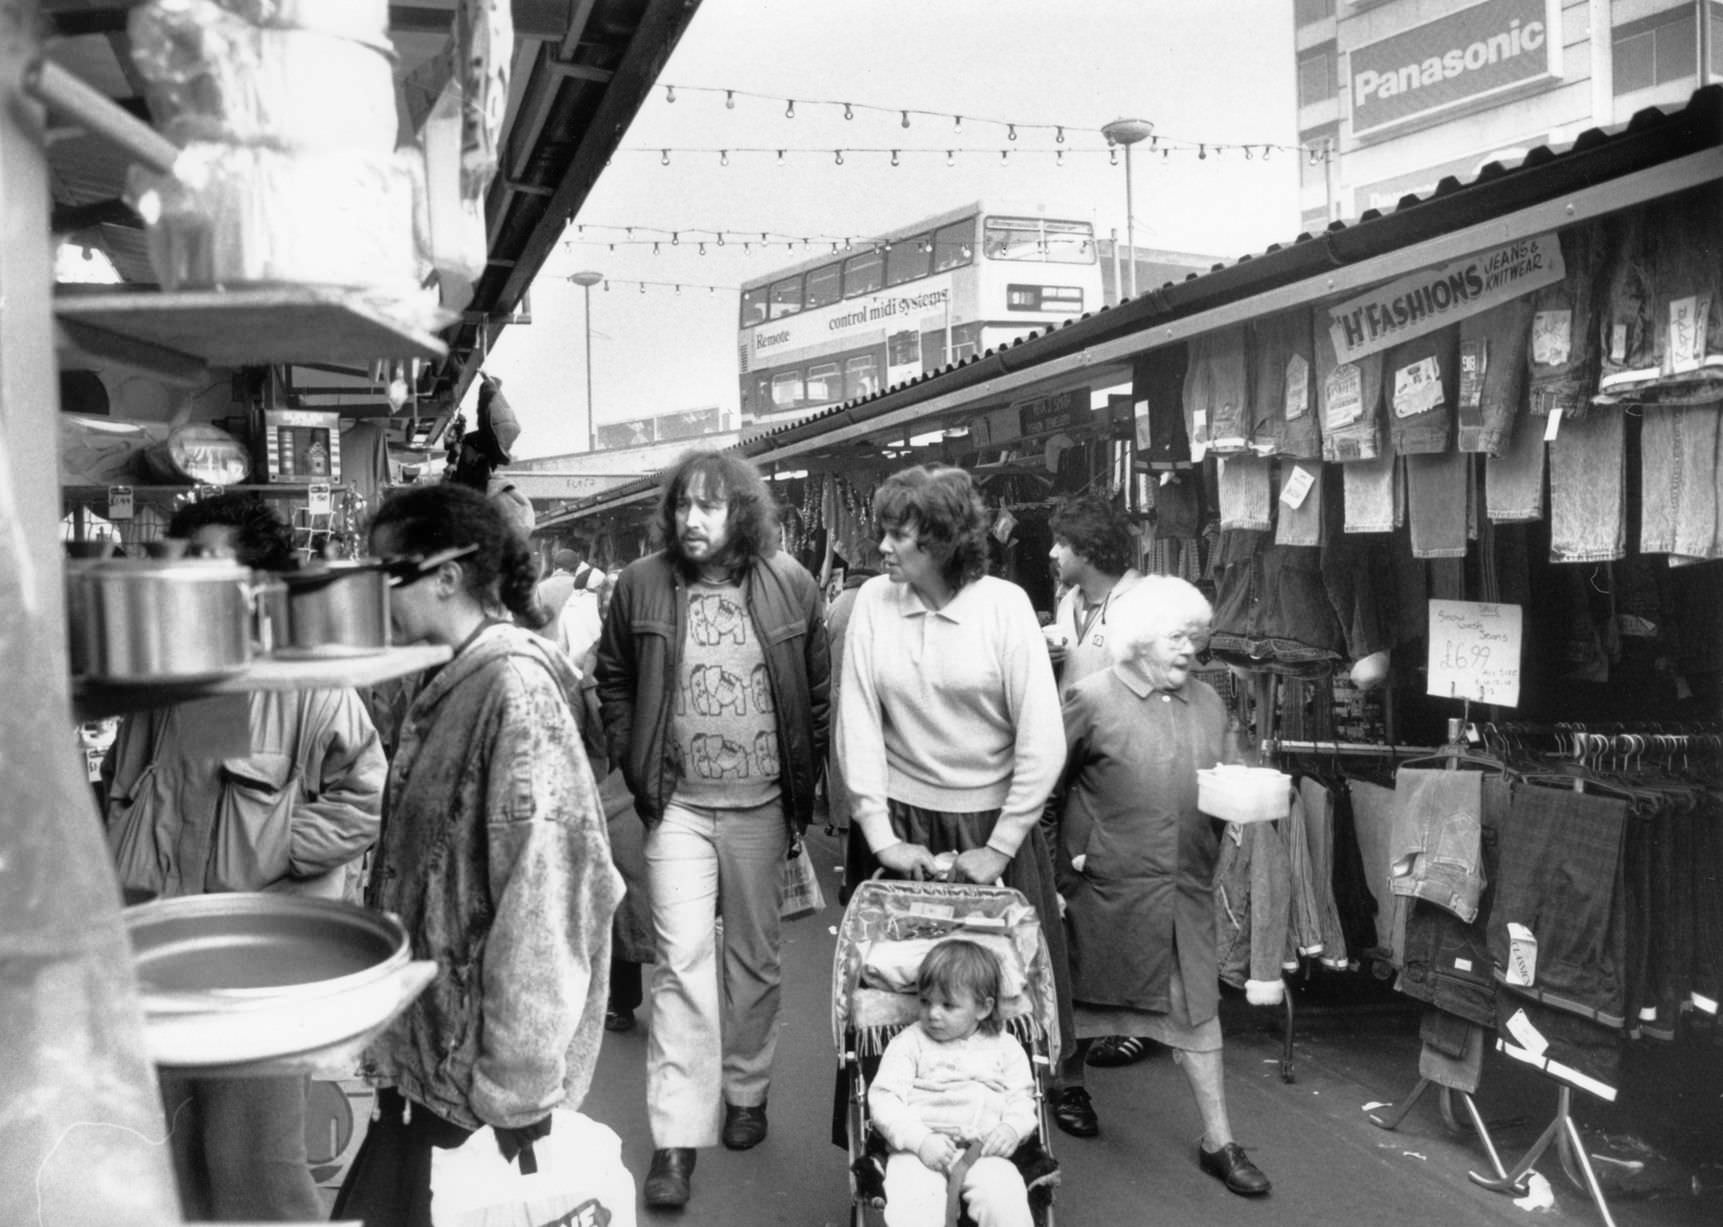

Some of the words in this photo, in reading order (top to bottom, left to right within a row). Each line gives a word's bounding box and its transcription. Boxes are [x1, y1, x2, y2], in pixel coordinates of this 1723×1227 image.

[1354, 18, 1546, 107] Panasonic
[1483, 240, 1531, 275] JEANS
[1530, 239, 1540, 253] &
[1484, 253, 1544, 291] KNITWEAR
[828, 305, 868, 331] control
[869, 299, 897, 321] midi
[899, 289, 949, 316] systems
[1365, 264, 1484, 338] FASHIONS
[756, 330, 790, 350] Remote
